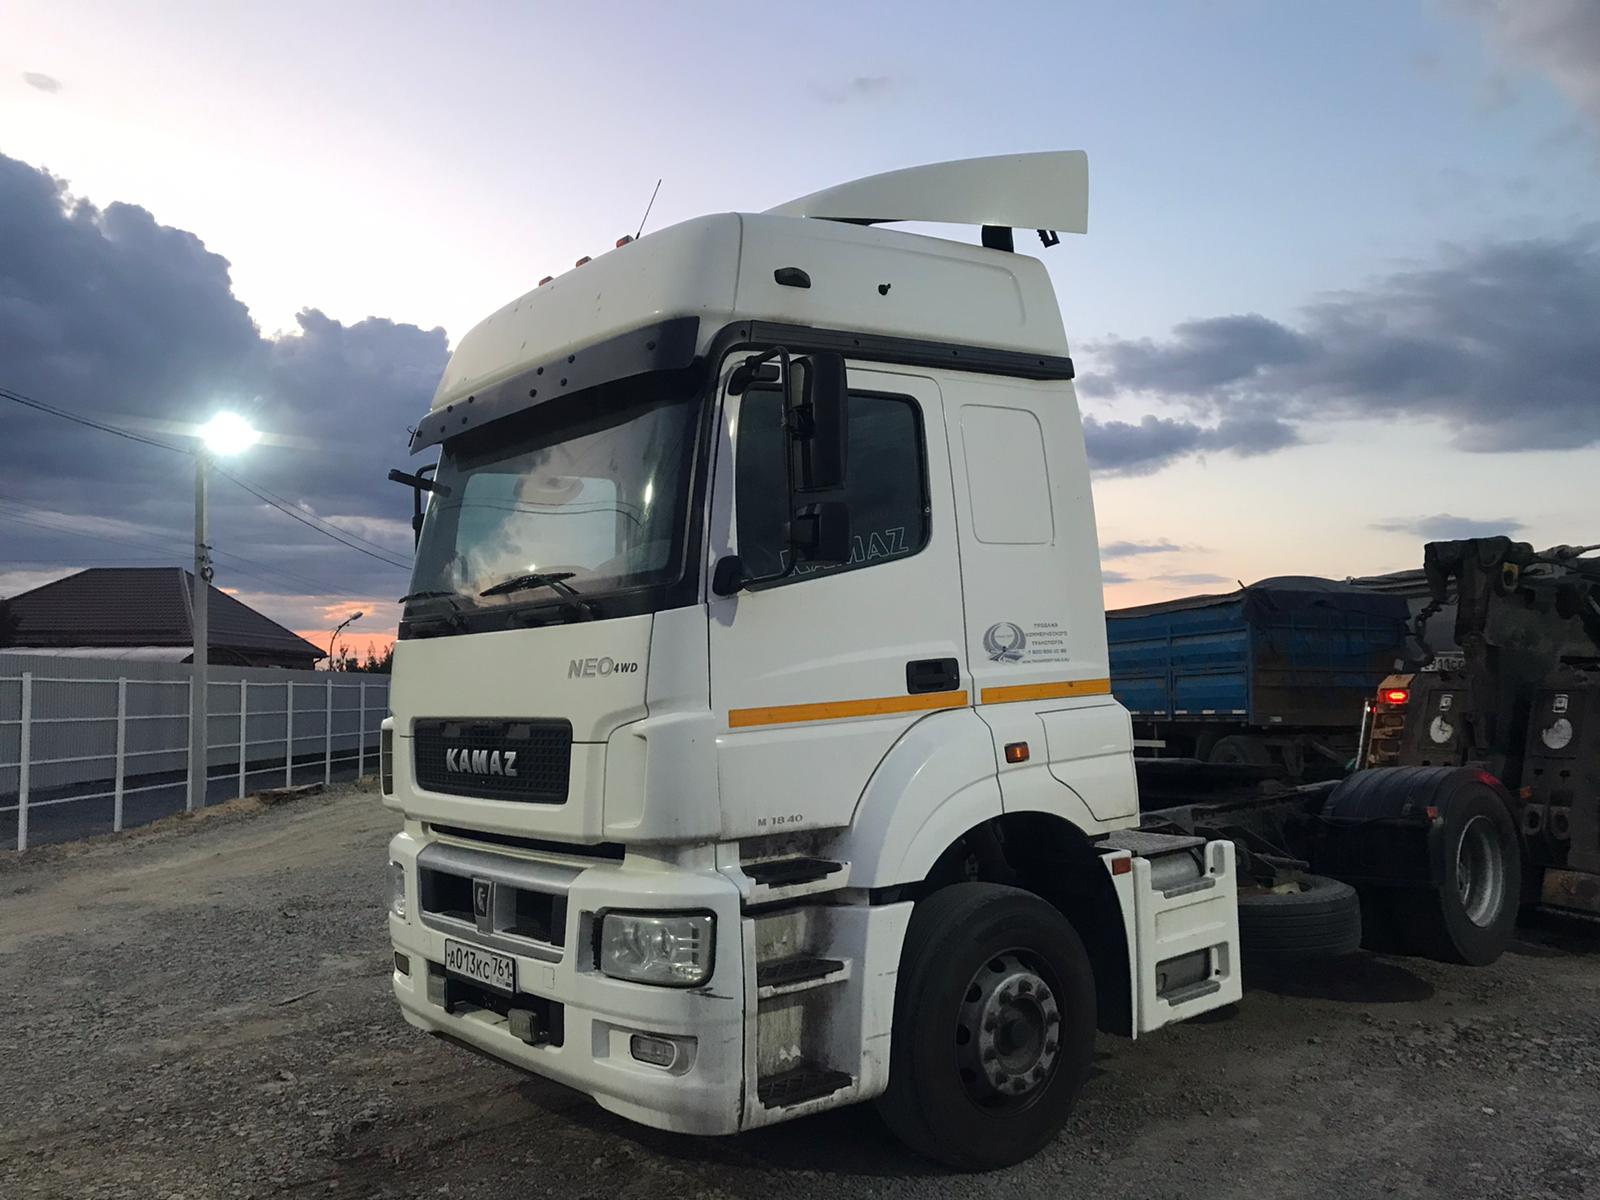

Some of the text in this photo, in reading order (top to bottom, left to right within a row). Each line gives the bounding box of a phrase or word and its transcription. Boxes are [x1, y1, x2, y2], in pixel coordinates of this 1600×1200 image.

[567, 656, 638, 679] NEO 4WD
[446, 748, 518, 777] KAMAZ
[757, 818, 767, 827] M
[492, 957, 510, 979] 761
